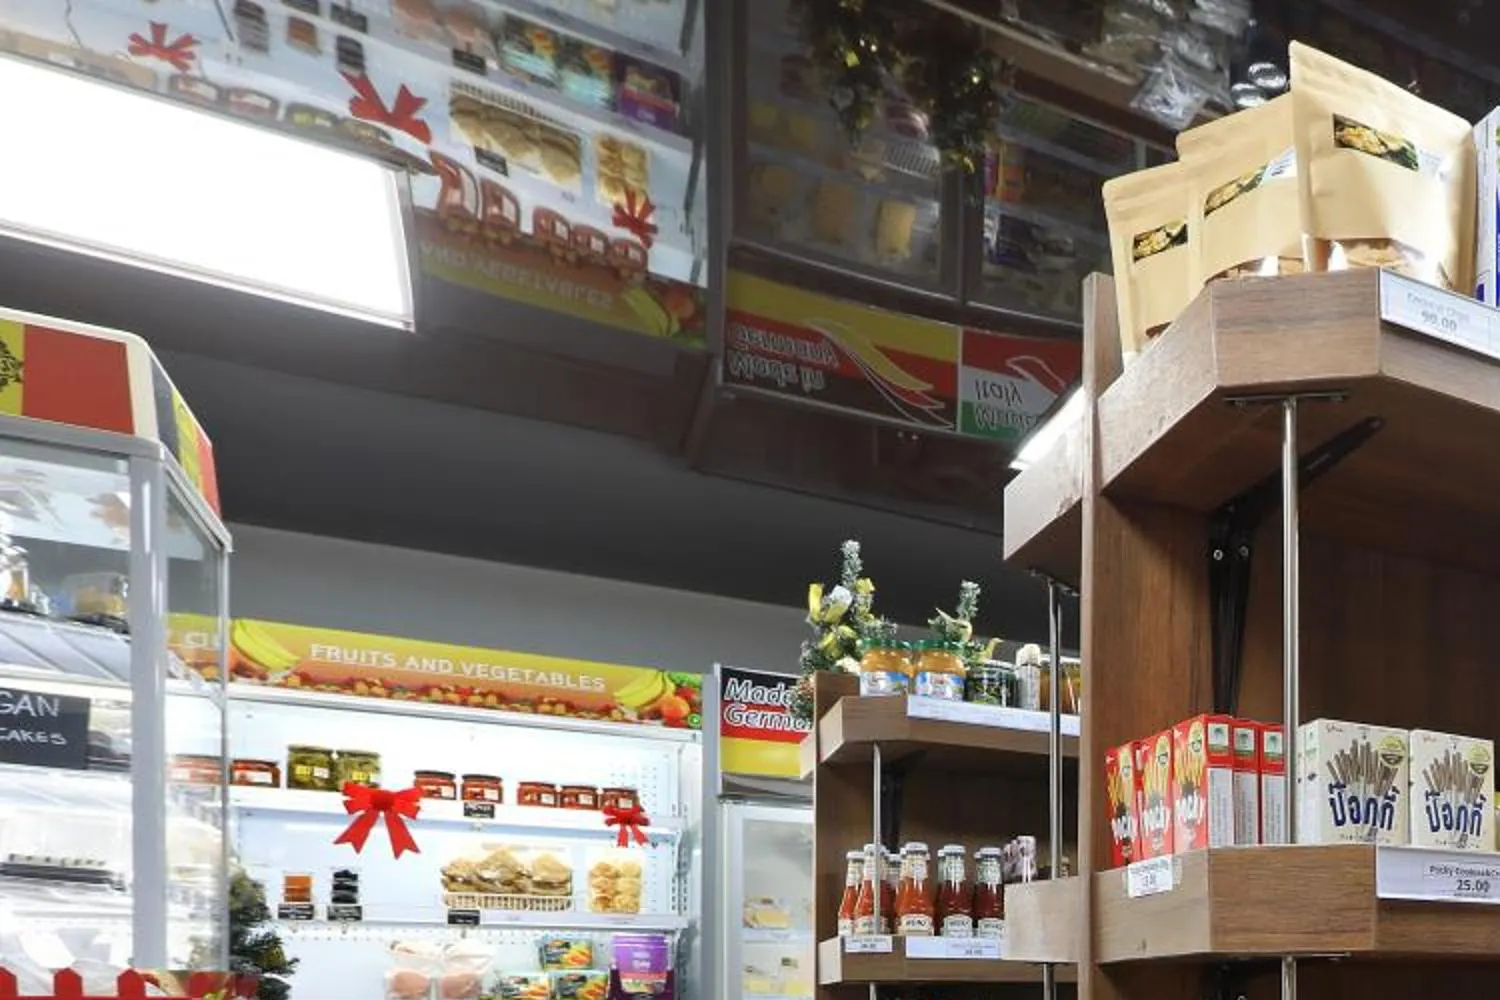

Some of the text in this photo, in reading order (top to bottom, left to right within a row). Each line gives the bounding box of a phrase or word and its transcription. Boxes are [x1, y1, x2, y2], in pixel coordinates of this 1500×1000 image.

[310, 643, 607, 692] FRUITS AND VEGETABLES
[1456, 879, 1491, 893] 25.00
